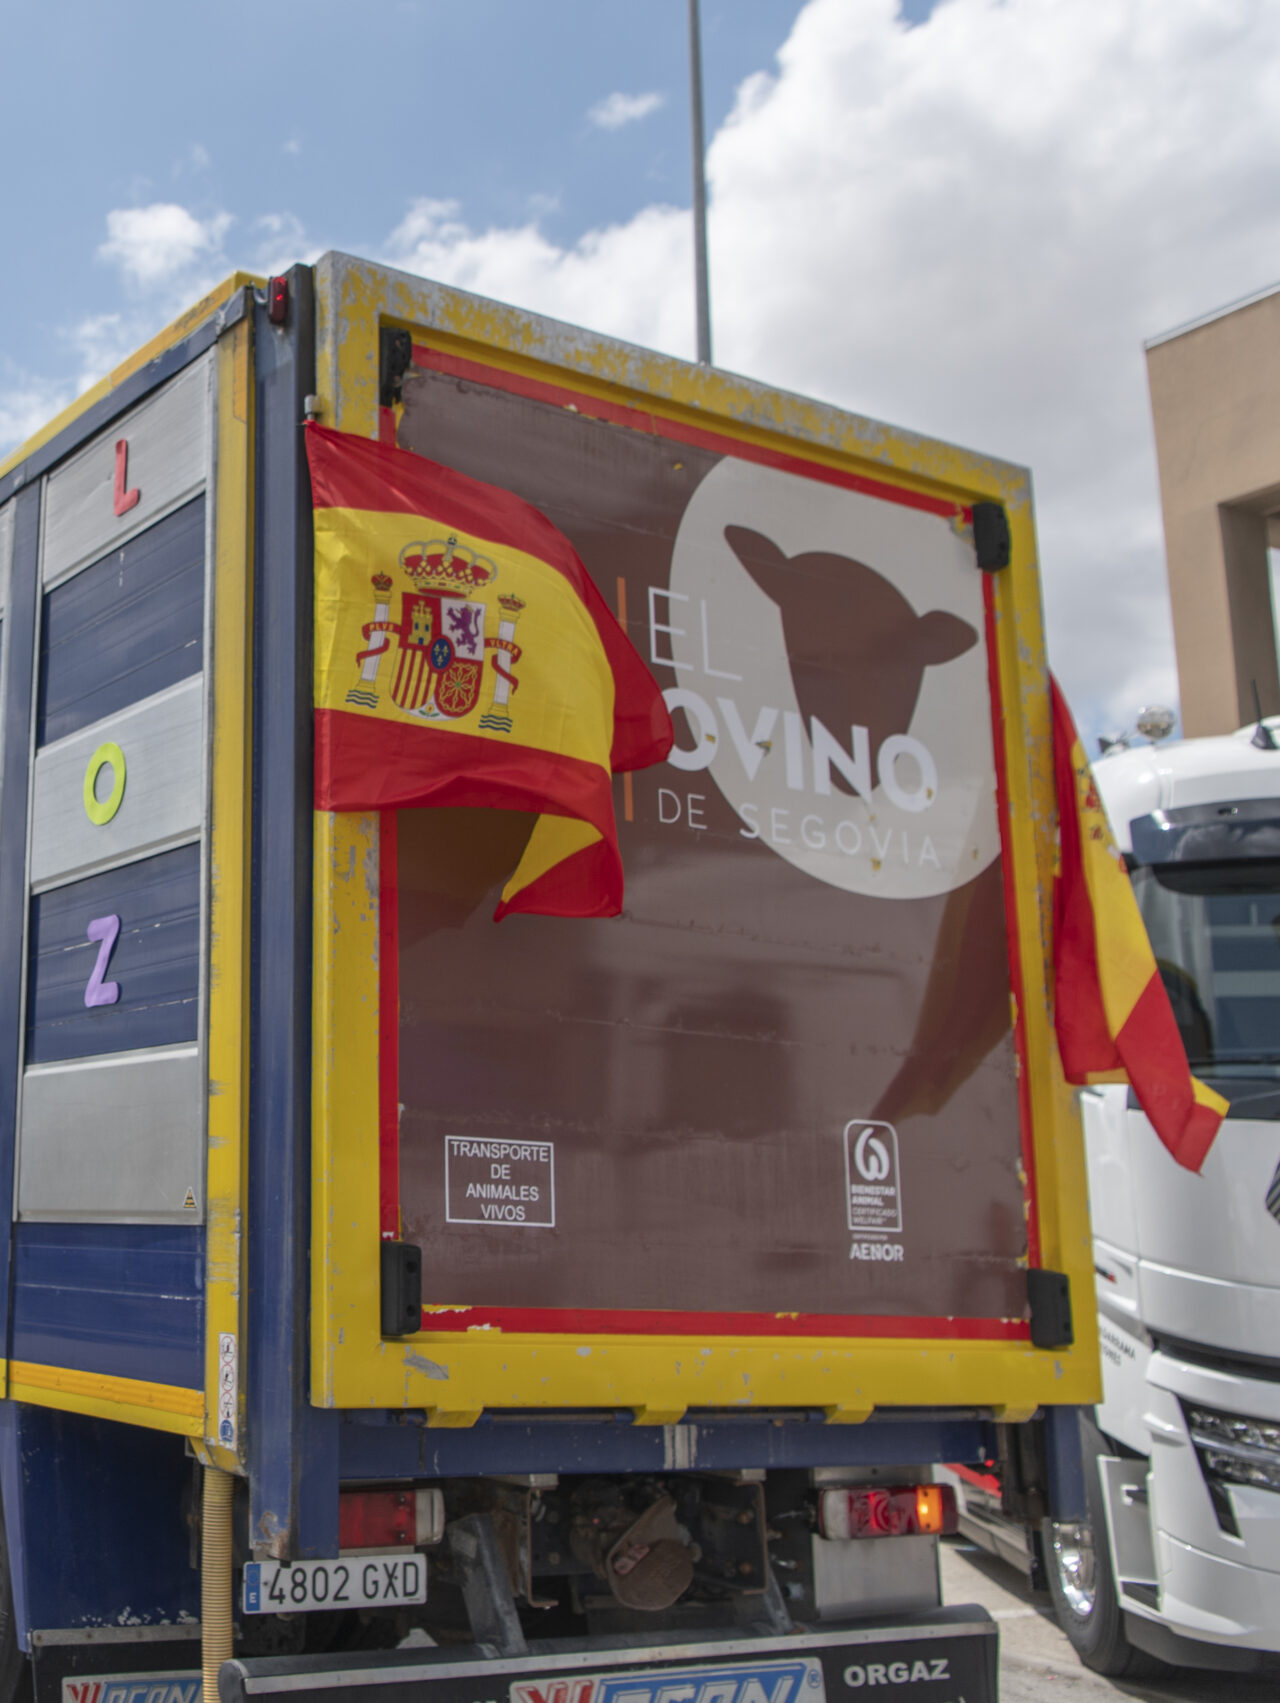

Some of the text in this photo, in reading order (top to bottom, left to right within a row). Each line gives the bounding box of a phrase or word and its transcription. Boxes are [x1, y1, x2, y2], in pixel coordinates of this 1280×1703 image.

[646, 585, 743, 682] EL
[660, 685, 938, 813] OVINO
[657, 788, 941, 870] DE SEGOVIA
[450, 1140, 549, 1162] TRANSPORTE
[490, 1163, 511, 1180] DE
[465, 1182, 539, 1201] ANIMALES
[851, 1184, 896, 1197] BIENESTAR
[480, 1203, 526, 1221] VIVOS
[850, 1242, 904, 1261] AENOR
[268, 1564, 350, 1605] 4802
[362, 1561, 419, 1600] GXD
[843, 1659, 951, 1688] ORGAZ
